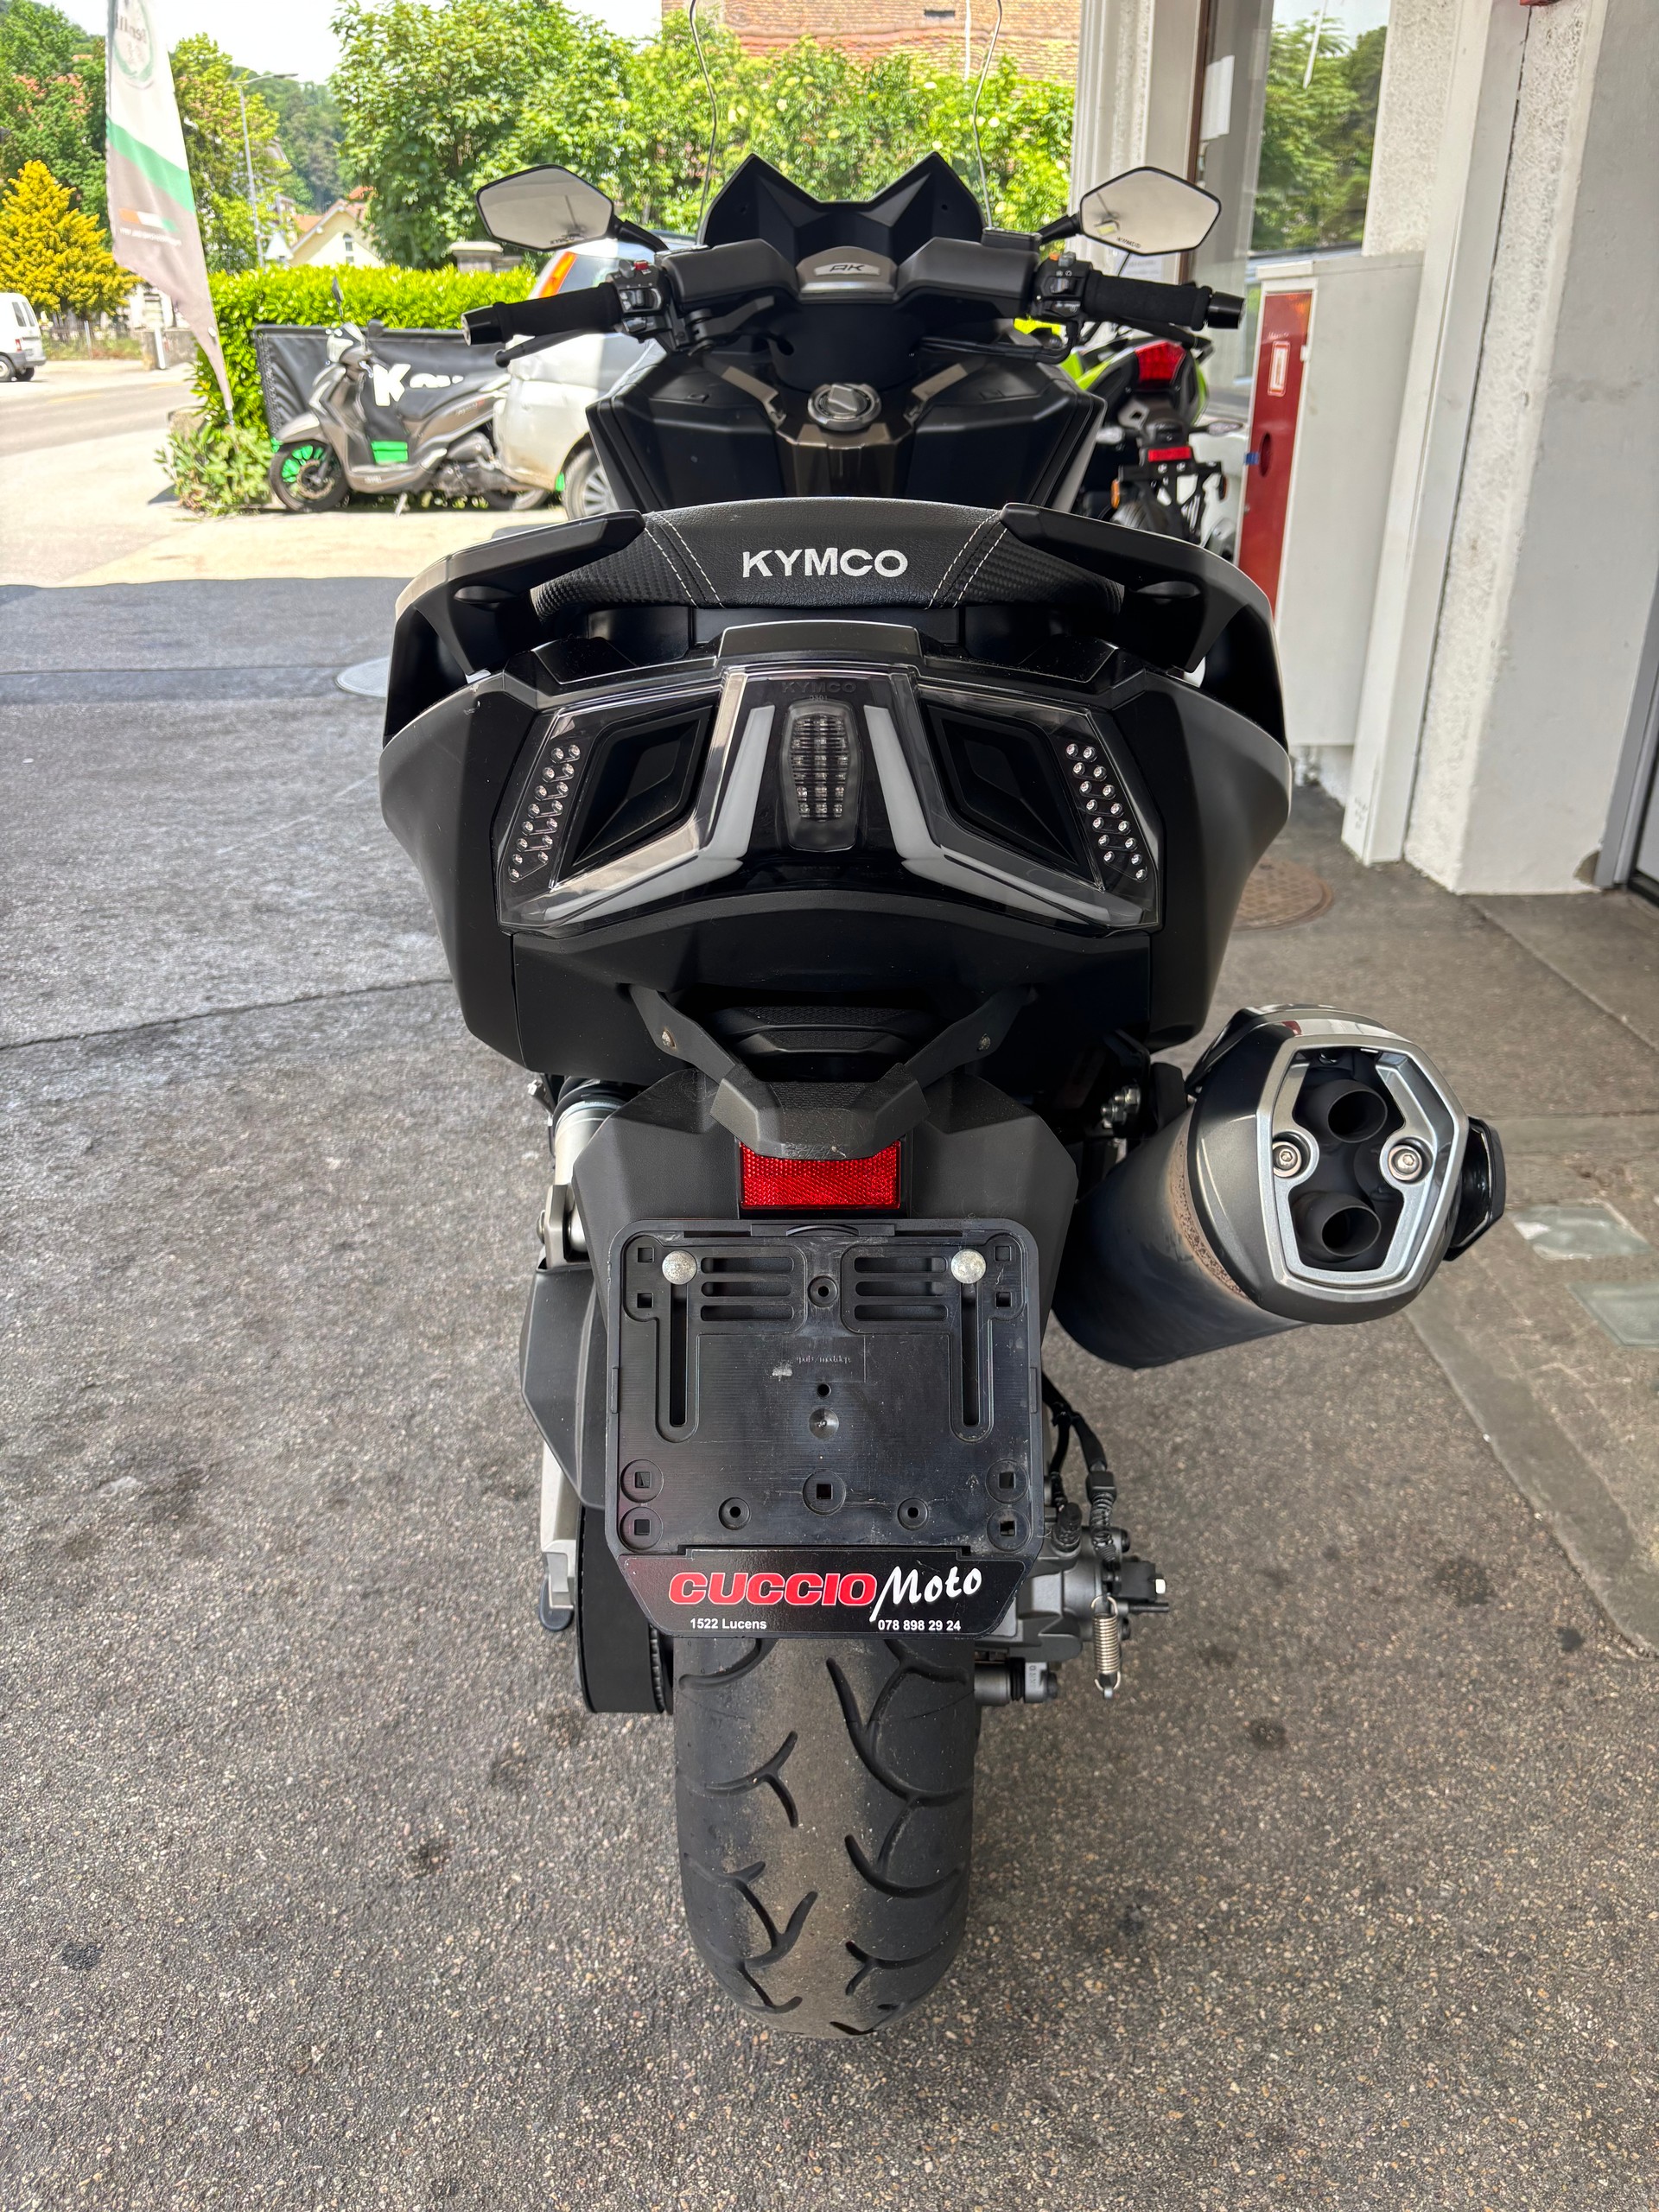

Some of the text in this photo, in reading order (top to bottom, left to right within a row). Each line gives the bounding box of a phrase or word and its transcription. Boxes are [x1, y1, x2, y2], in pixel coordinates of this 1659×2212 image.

[742, 547, 908, 578] KYMCO
[782, 681, 856, 693] KYMCO
[669, 1566, 982, 1622] CUCCIO Moto
[690, 1618, 767, 1630] 1522 Lucens
[878, 1619, 961, 1631] 078 898 29 24
